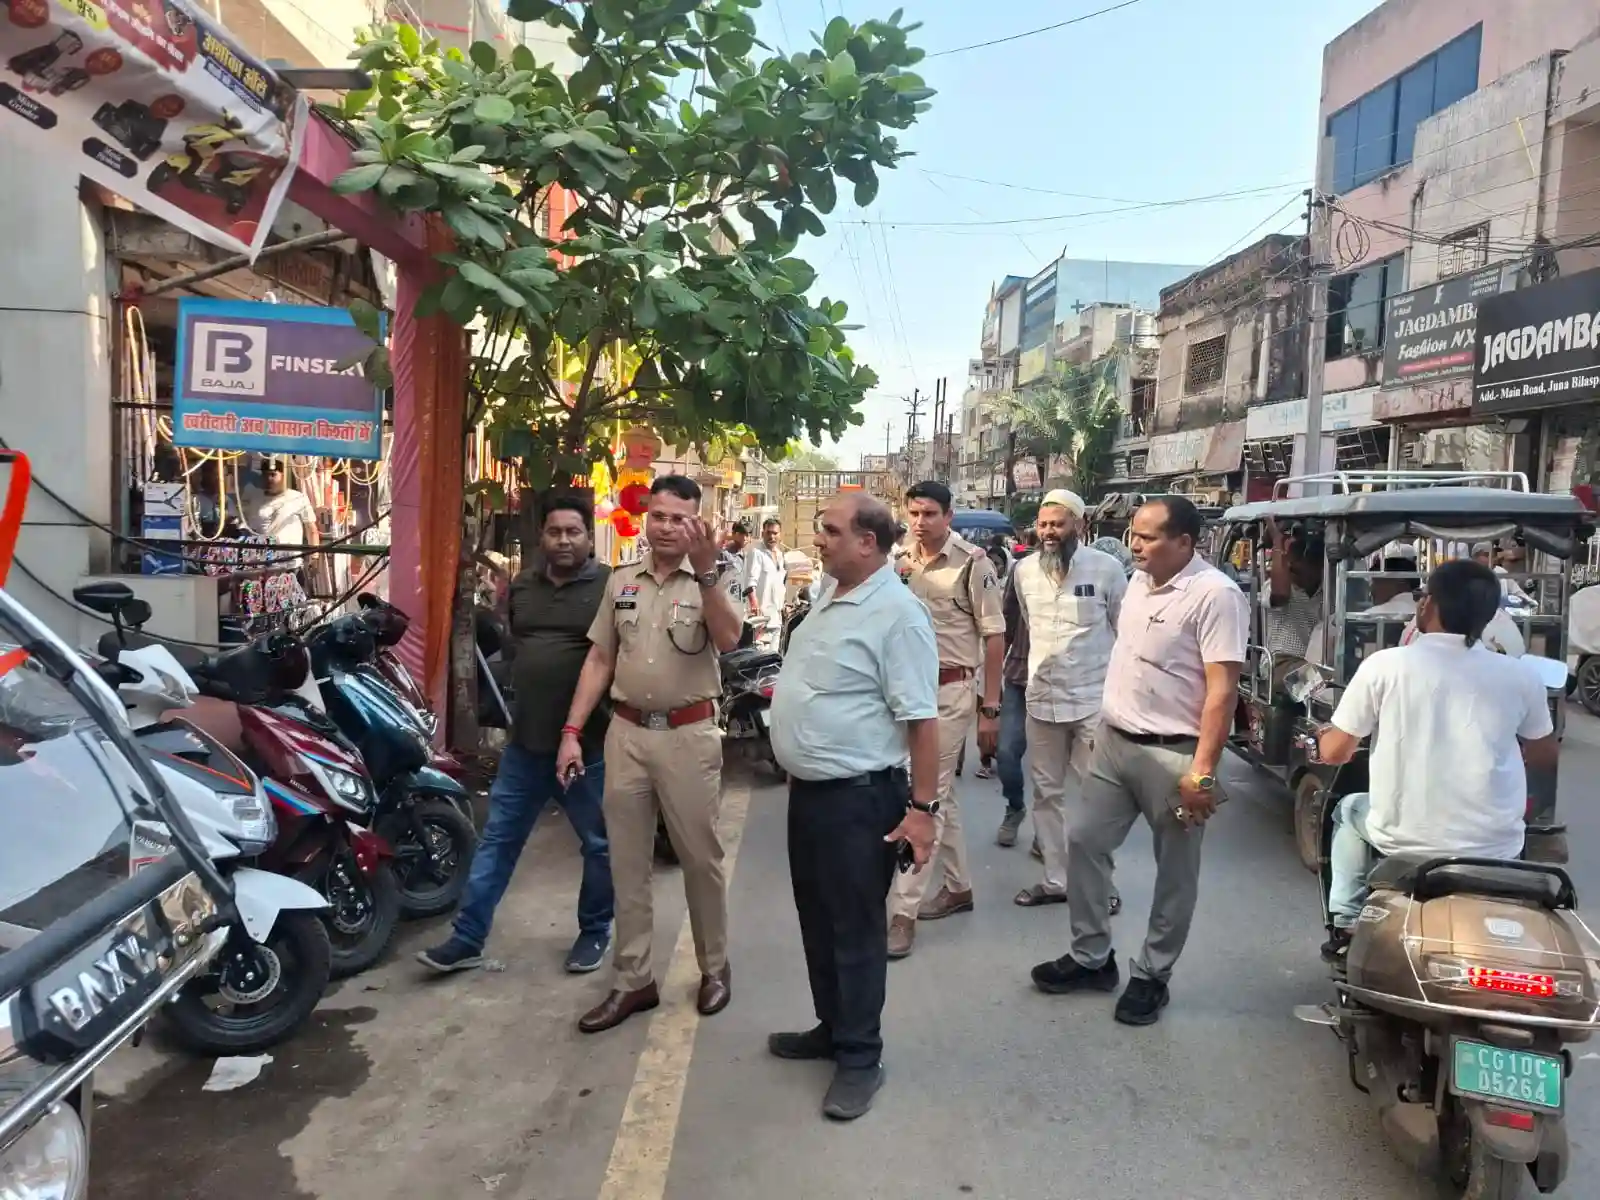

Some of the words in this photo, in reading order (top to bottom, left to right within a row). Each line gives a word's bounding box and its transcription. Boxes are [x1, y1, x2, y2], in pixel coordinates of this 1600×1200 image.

[1394, 302, 1477, 339] JAGDAMB
[1397, 337, 1447, 361] Fashion
[1481, 311, 1600, 375] JAGDAMBA
[200, 378, 255, 391] BAJAJ
[1500, 387, 1521, 400] Main
[1522, 382, 1547, 396] Road,
[1548, 380, 1569, 393] Juna
[1571, 375, 1600, 389] Bilasp
[182, 409, 237, 433] खरीदारी
[240, 417, 266, 436] अब
[267, 419, 313, 440] आसान
[358, 420, 373, 444] में
[48, 934, 157, 1032] BAXY
